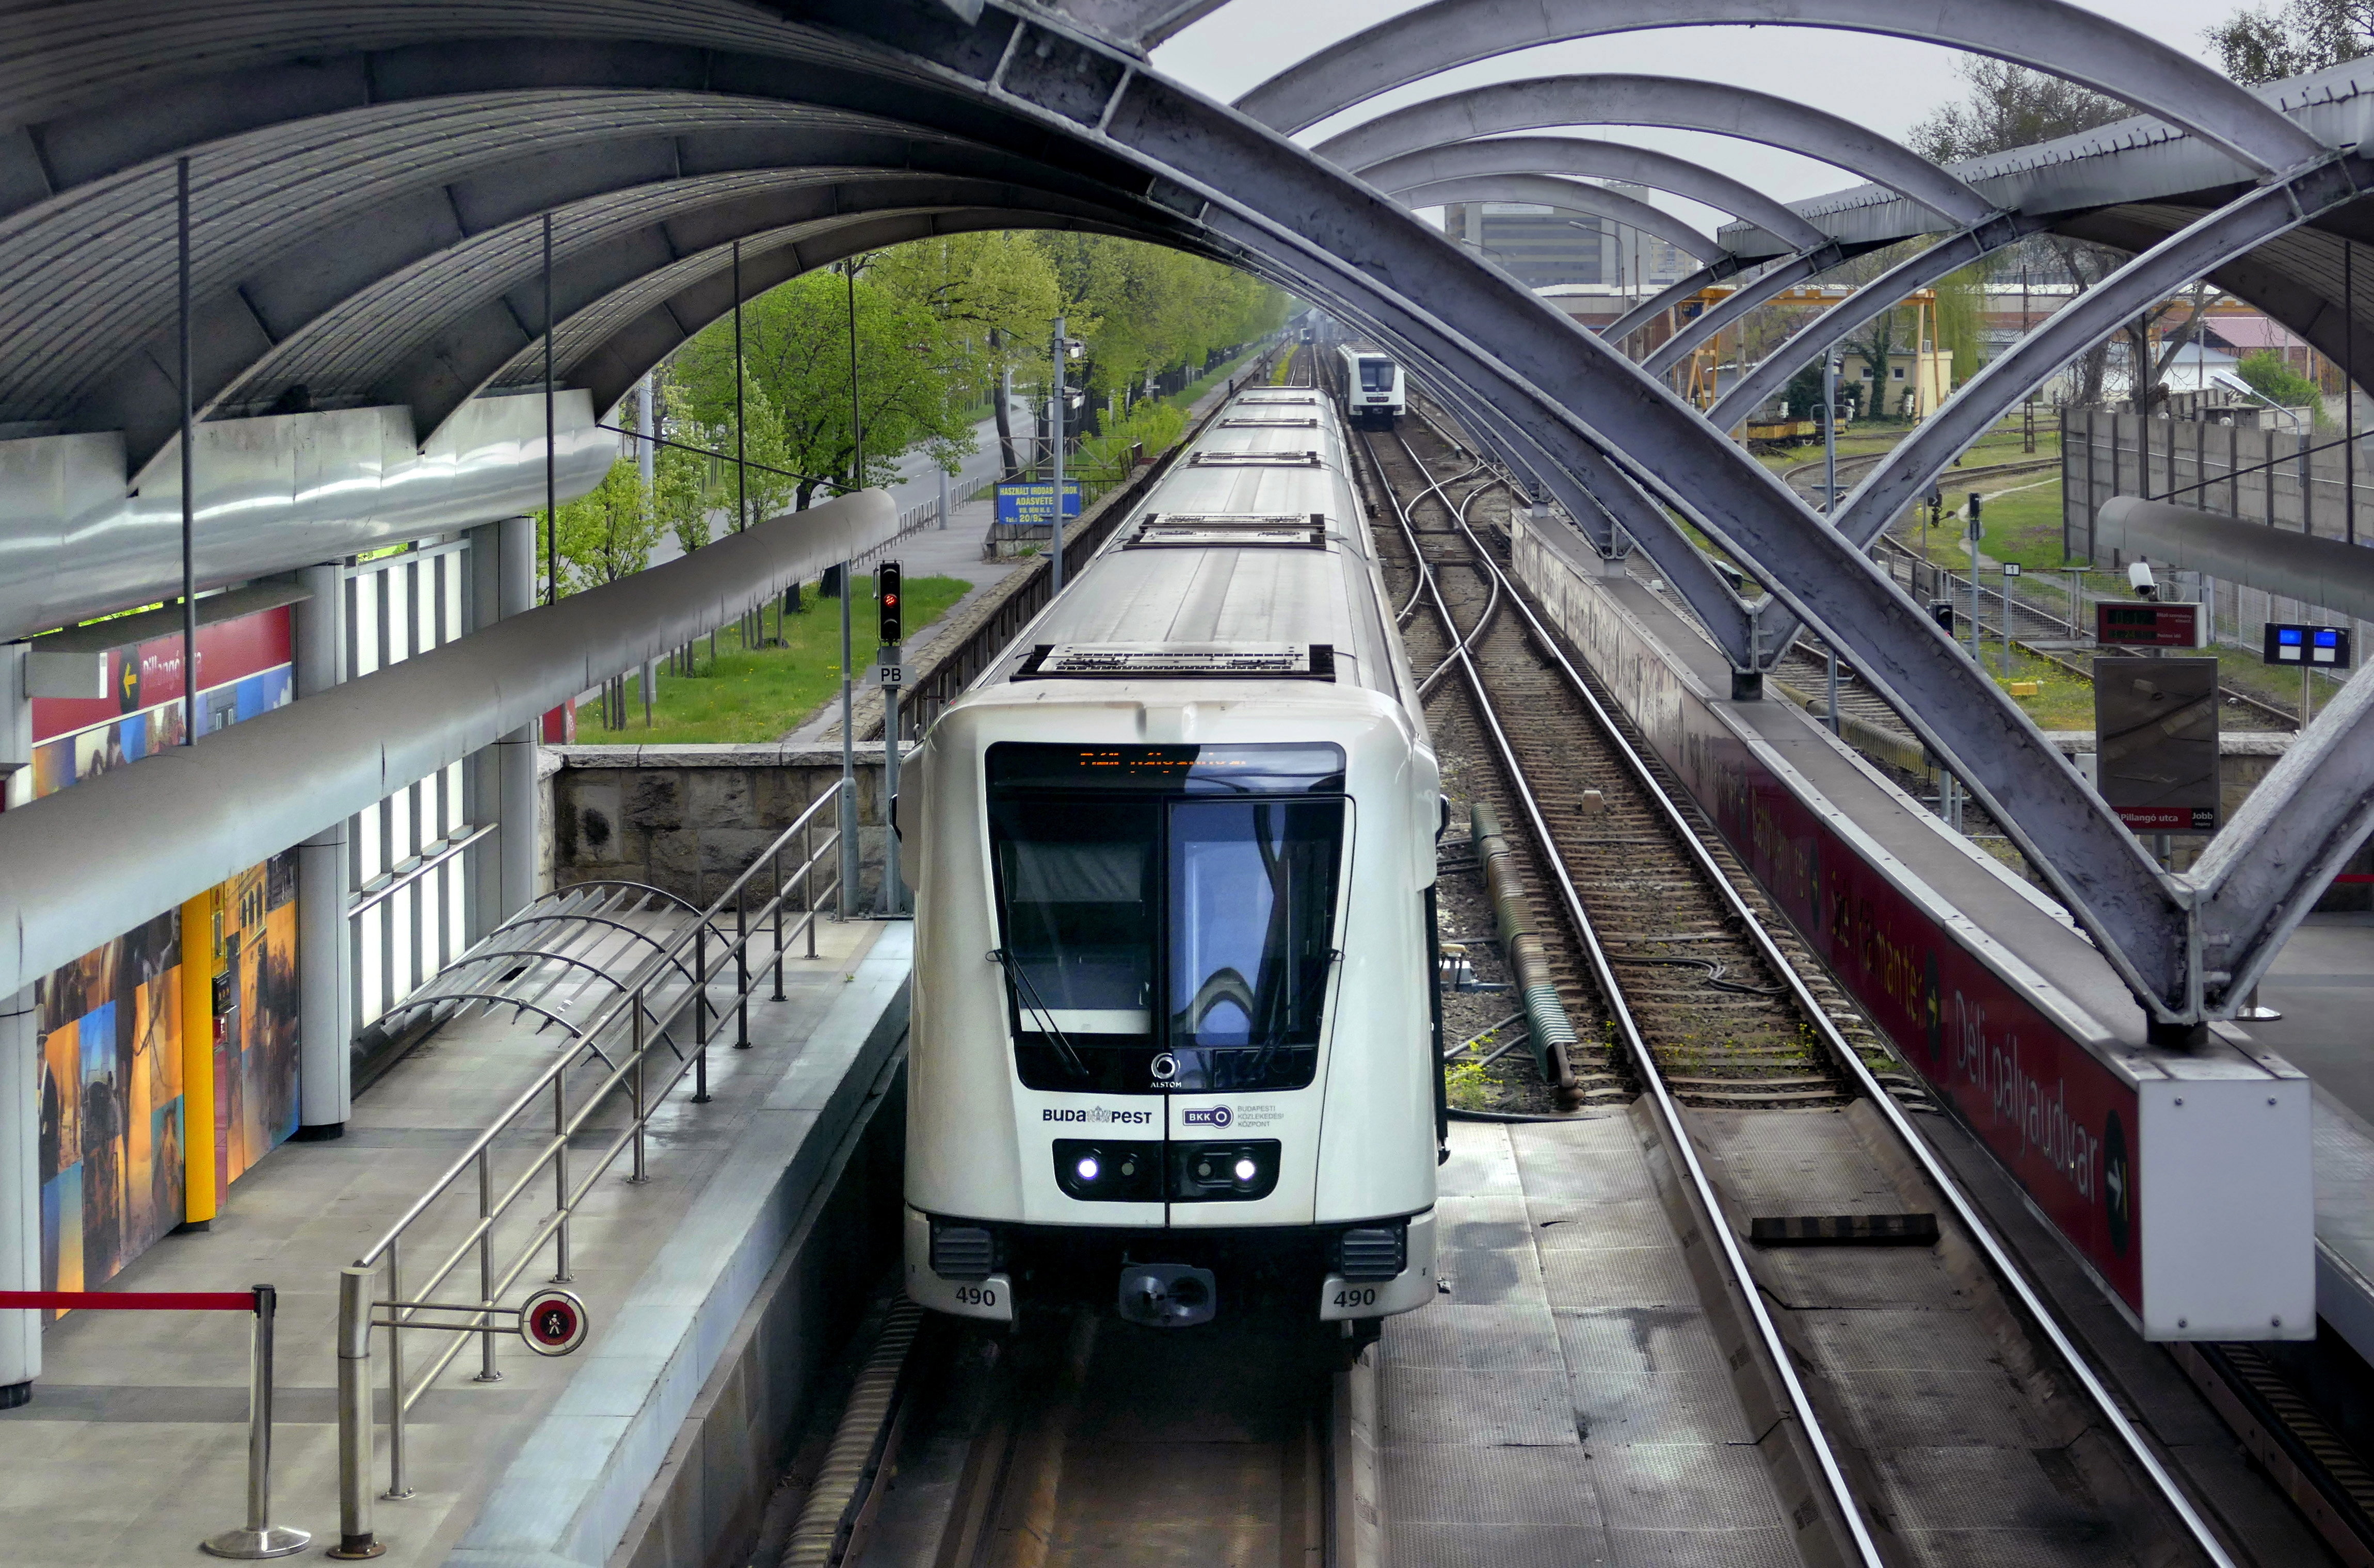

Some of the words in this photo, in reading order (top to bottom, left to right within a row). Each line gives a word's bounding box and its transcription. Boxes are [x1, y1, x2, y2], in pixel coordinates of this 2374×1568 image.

[1000, 486, 1029, 495] HASZNÁLT
[1031, 487, 1077, 495] IRODABOROK
[1016, 495, 1053, 506] ADÁSVÉTE
[881, 668, 901, 682] PB
[2121, 813, 2156, 823] Pillangó
[1956, 989, 1986, 1093] Déli
[1993, 1032, 2098, 1205] pályaudvar
[955, 1286, 996, 1306] 490
[1334, 1289, 1375, 1307] 490
